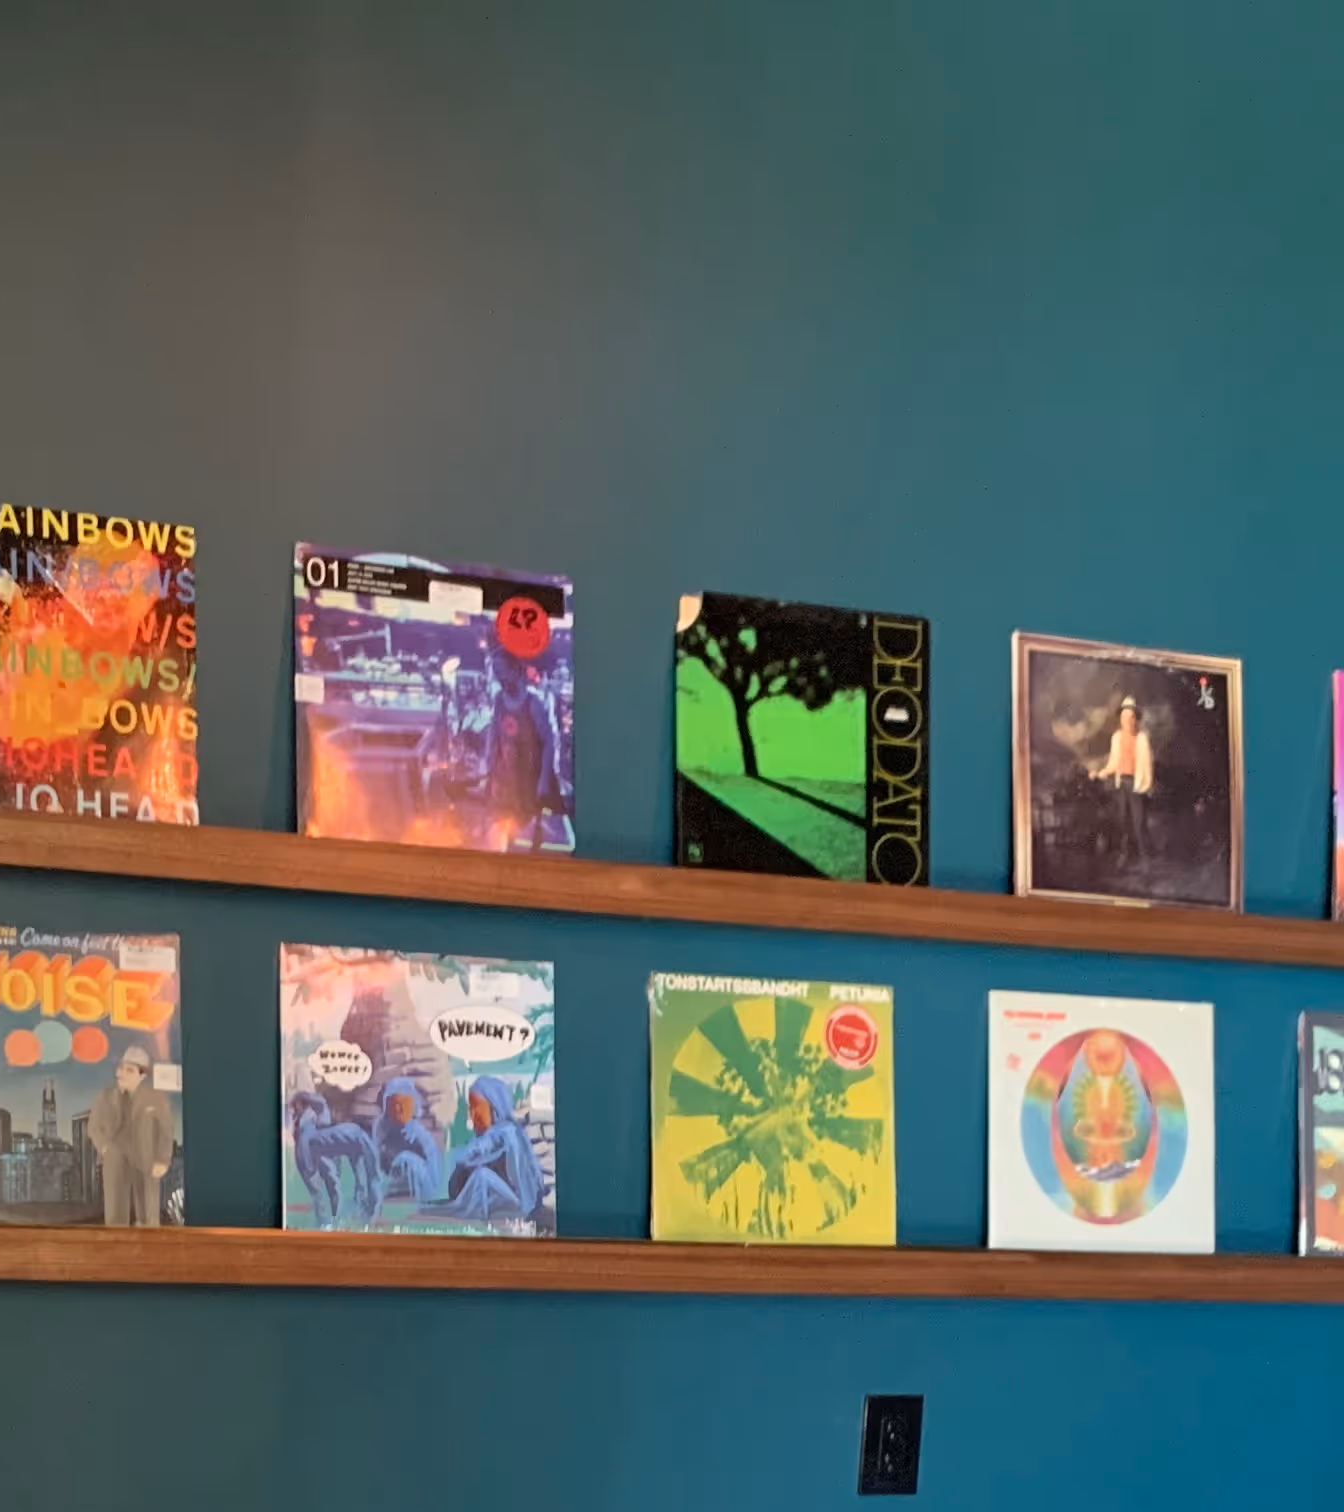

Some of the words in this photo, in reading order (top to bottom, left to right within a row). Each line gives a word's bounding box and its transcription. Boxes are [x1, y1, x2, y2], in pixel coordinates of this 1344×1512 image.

[307, 556, 340, 588] 01
[872, 614, 923, 887] DEODATO
[19, 926, 60, 948] Come
